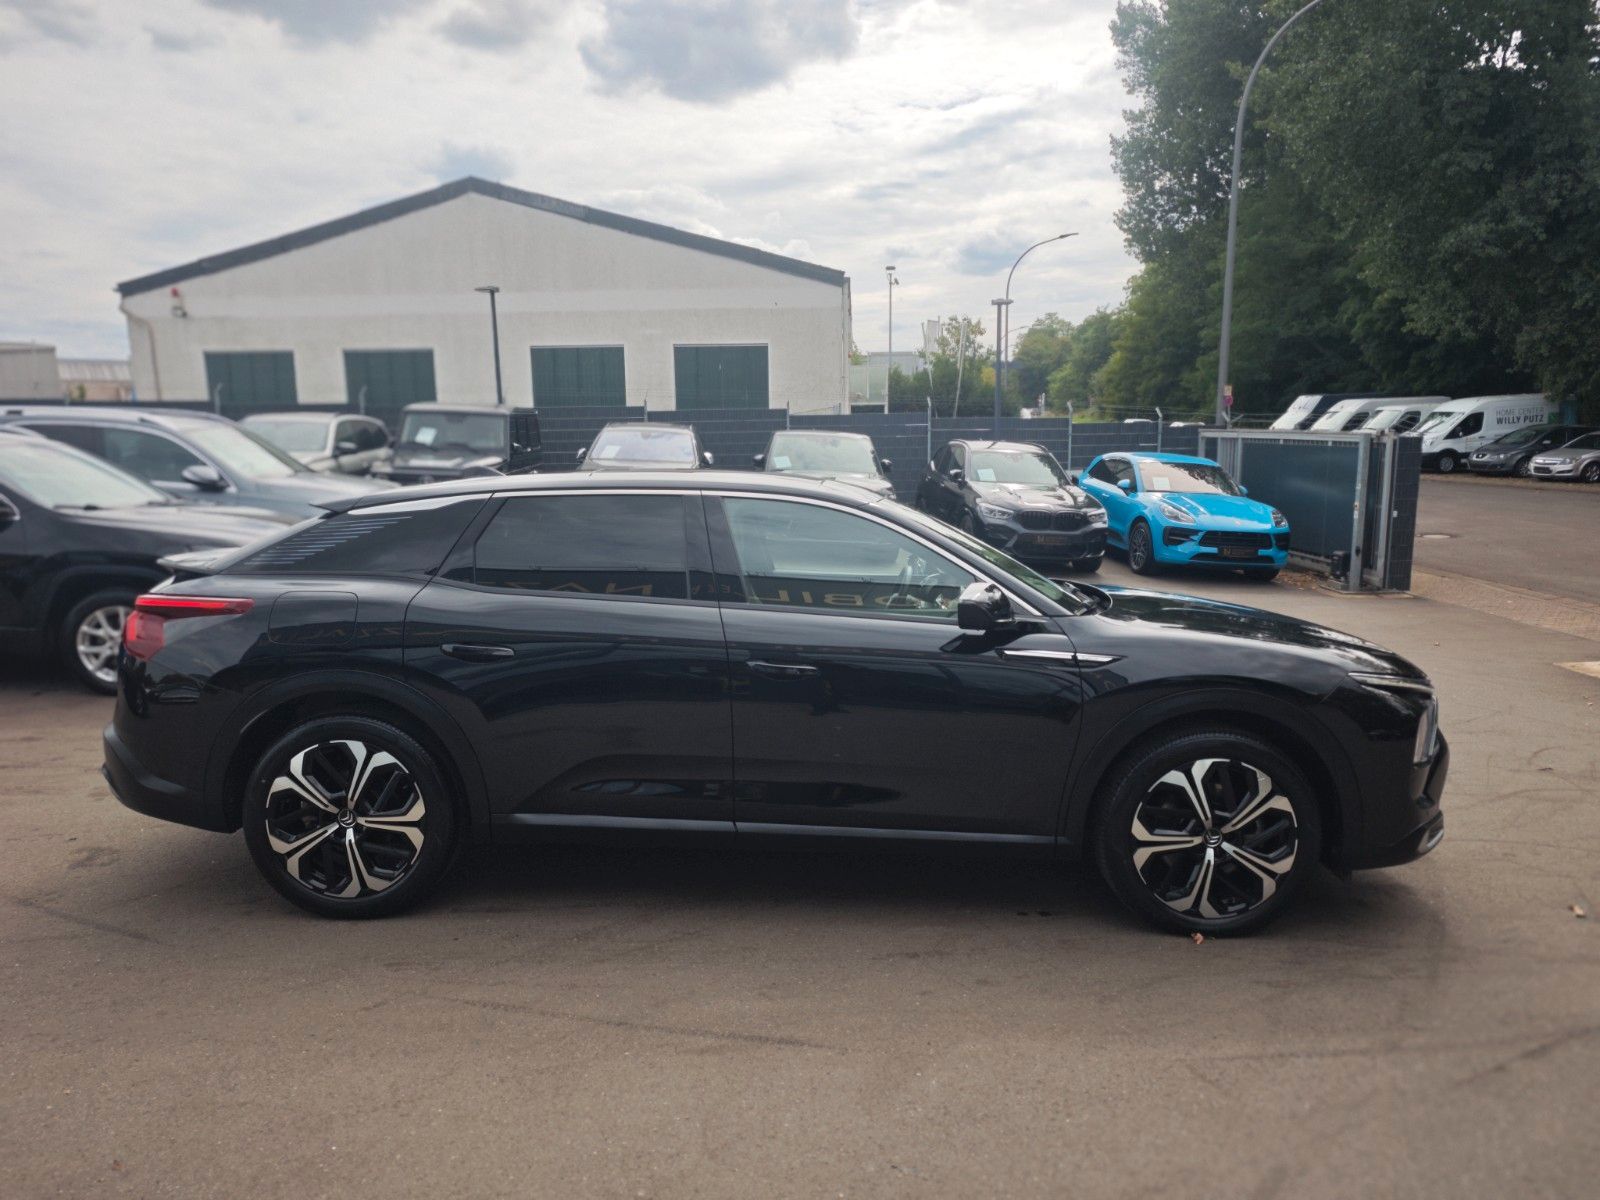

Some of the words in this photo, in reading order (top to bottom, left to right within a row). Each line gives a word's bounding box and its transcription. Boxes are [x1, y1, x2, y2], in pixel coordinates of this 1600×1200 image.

[1496, 408, 1516, 416] HOME
[1496, 416, 1521, 424] WILLY
[1523, 415, 1544, 423] PUTZ
